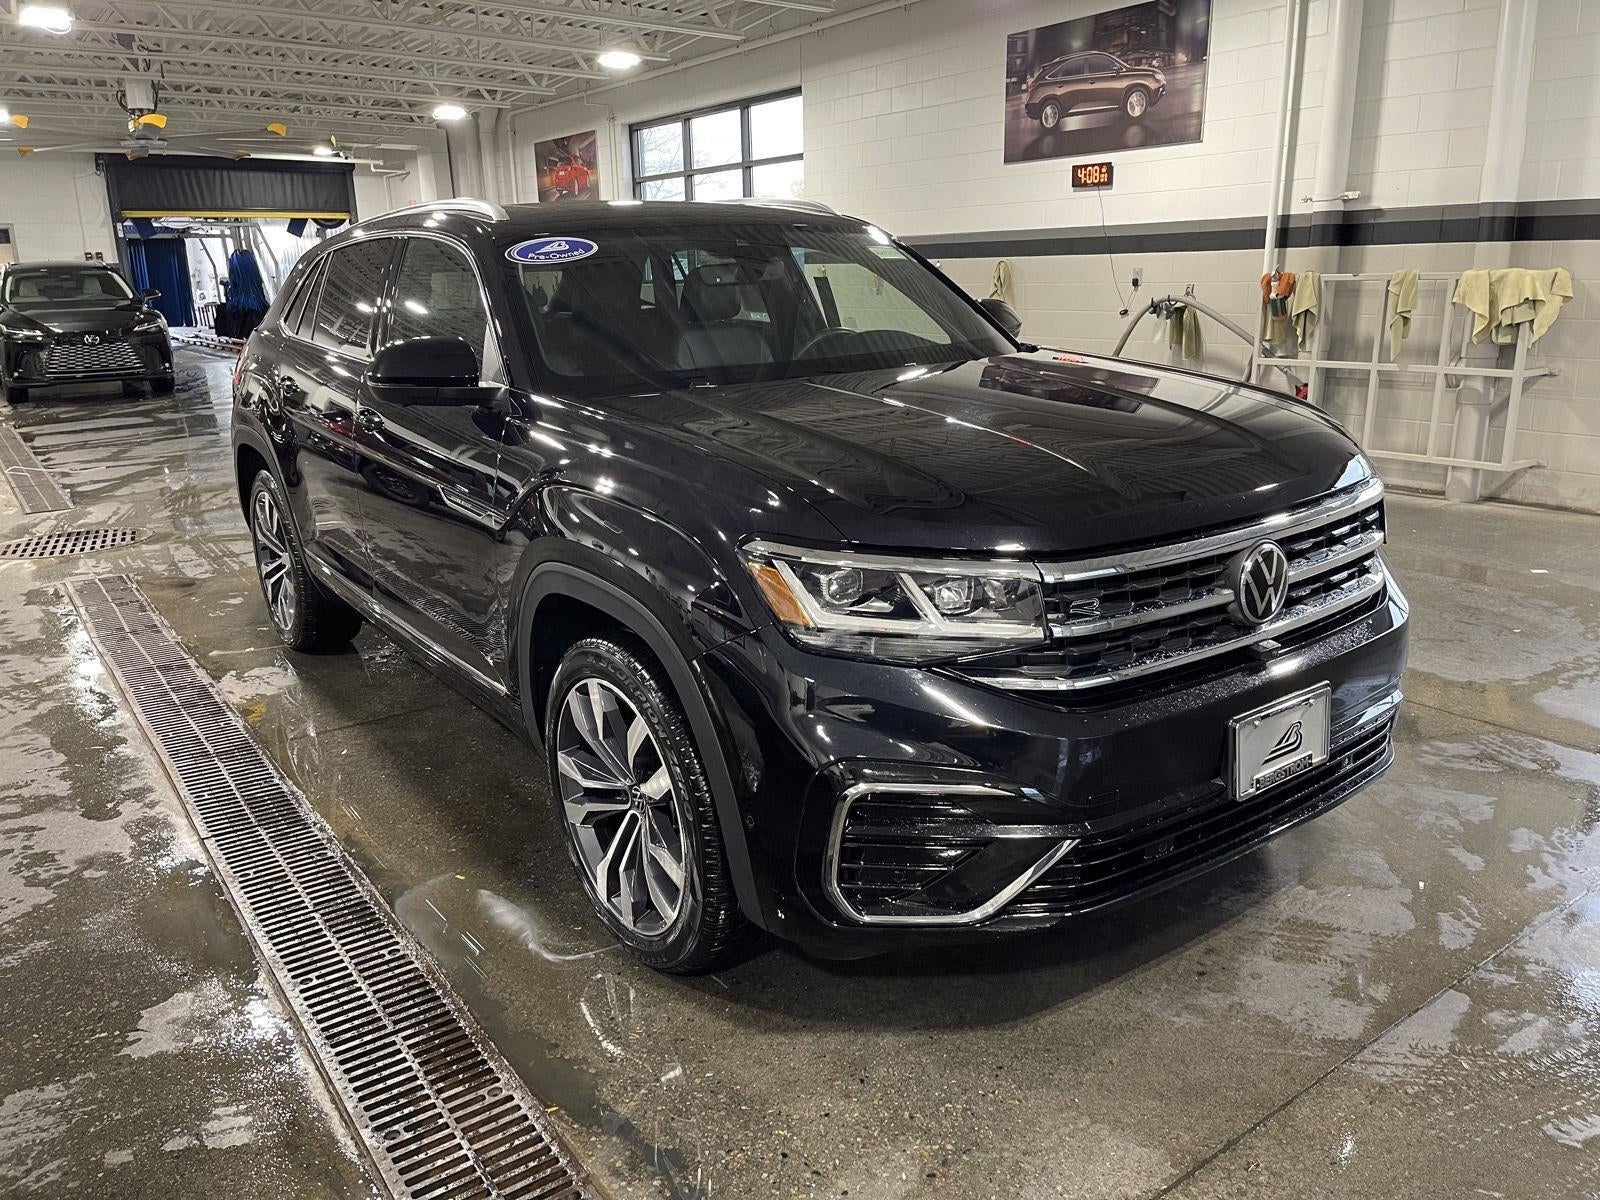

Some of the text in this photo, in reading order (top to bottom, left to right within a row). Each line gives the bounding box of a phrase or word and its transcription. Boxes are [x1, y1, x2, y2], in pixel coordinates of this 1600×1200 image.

[1077, 165, 1100, 184] 4:08
[527, 248, 586, 260] Pre-Owned
[1257, 757, 1310, 789] BERGSTROM
